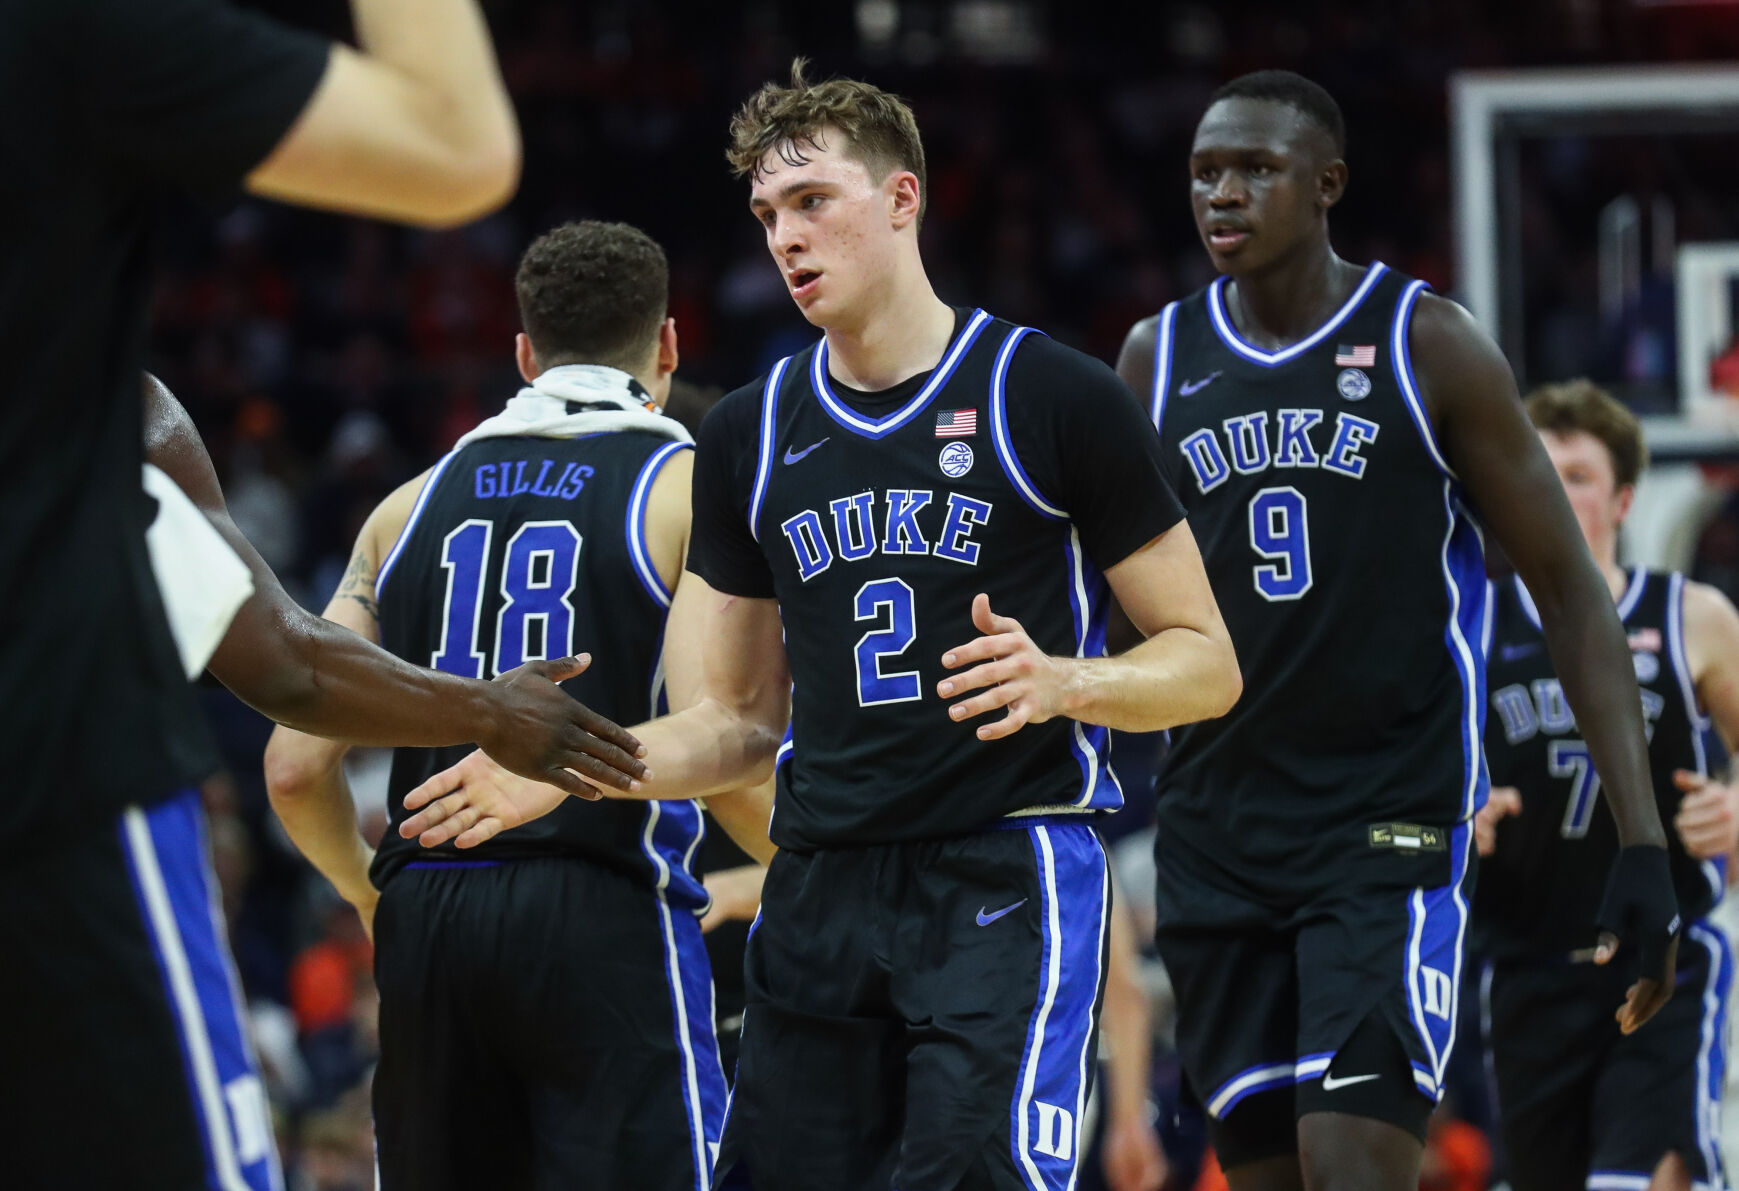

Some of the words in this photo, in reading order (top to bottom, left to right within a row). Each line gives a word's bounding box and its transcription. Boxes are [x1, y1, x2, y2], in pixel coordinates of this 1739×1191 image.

[475, 459, 595, 500] GILLIS
[1180, 409, 1380, 494] DUKE
[781, 489, 993, 582] DUKE
[1249, 486, 1313, 602] 9
[431, 518, 579, 681] 18
[854, 577, 922, 707] 2
[1548, 739, 1600, 839] 7
[1420, 964, 1452, 1021] D
[1033, 1100, 1073, 1161] D
